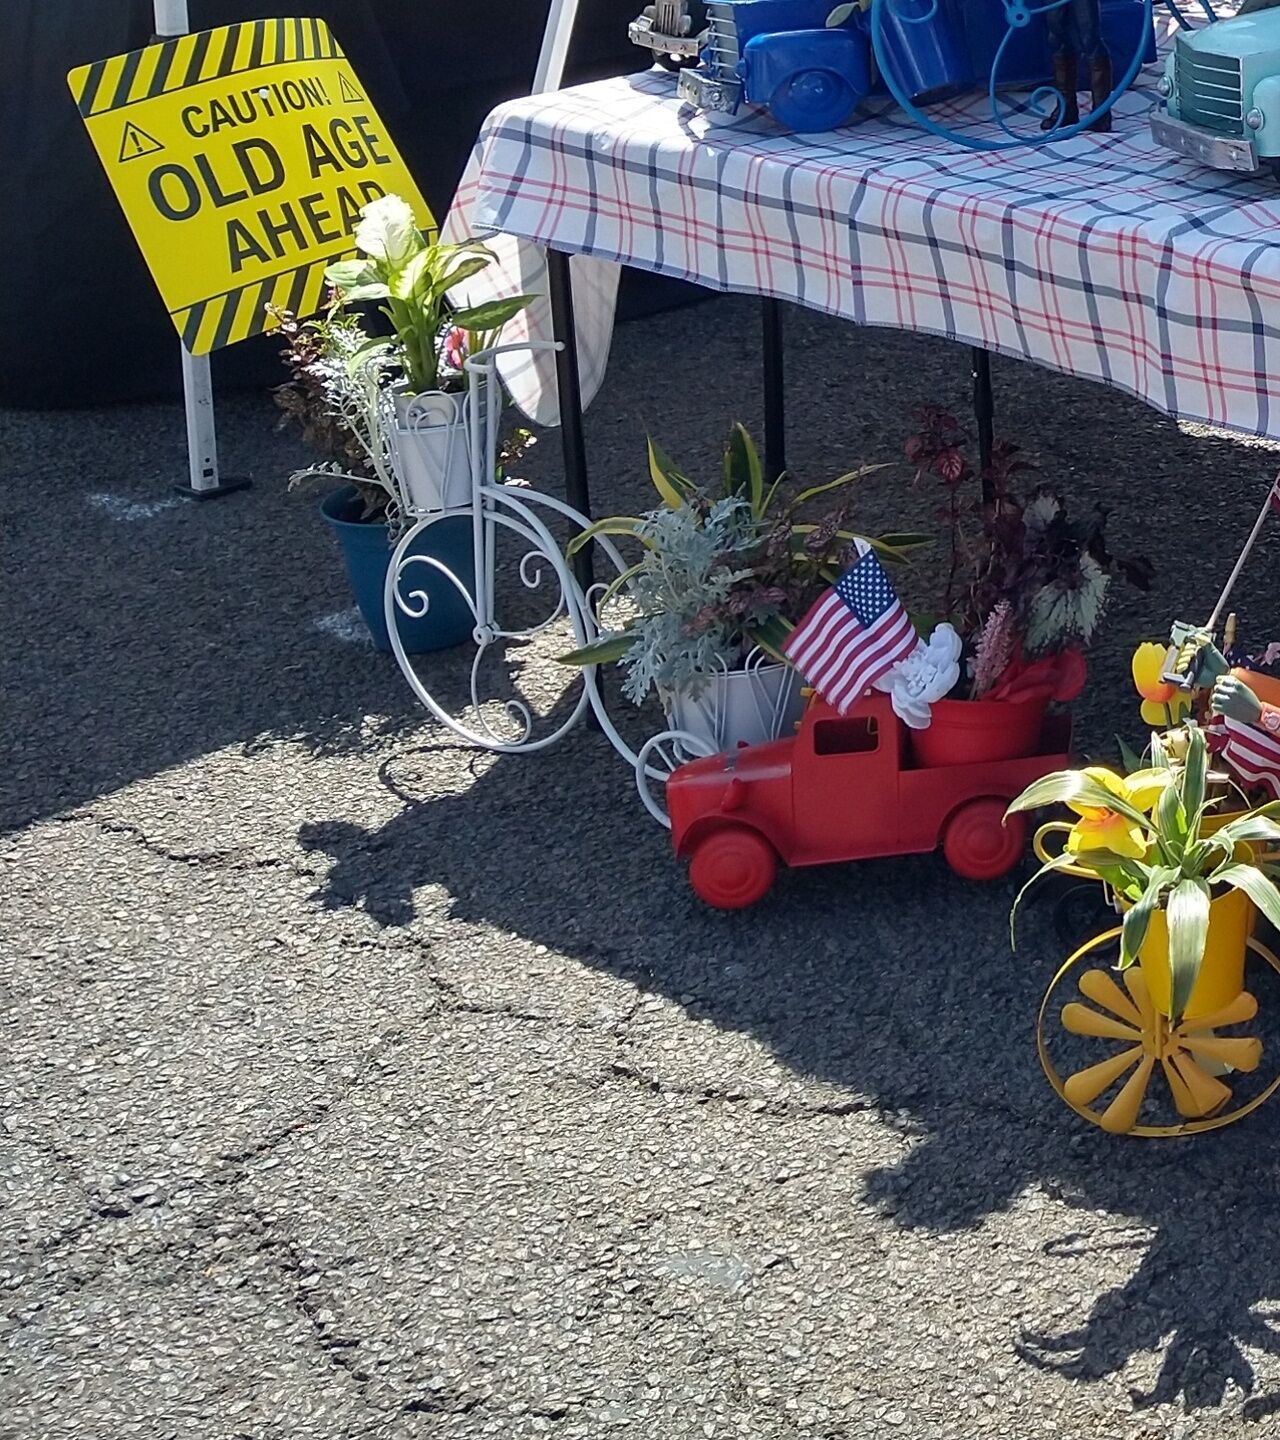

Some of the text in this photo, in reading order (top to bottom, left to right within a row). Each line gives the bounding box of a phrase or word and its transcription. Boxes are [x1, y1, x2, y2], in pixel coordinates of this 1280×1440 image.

[181, 76, 332, 138] CAUTION!
[147, 115, 391, 222] OLD AGE
